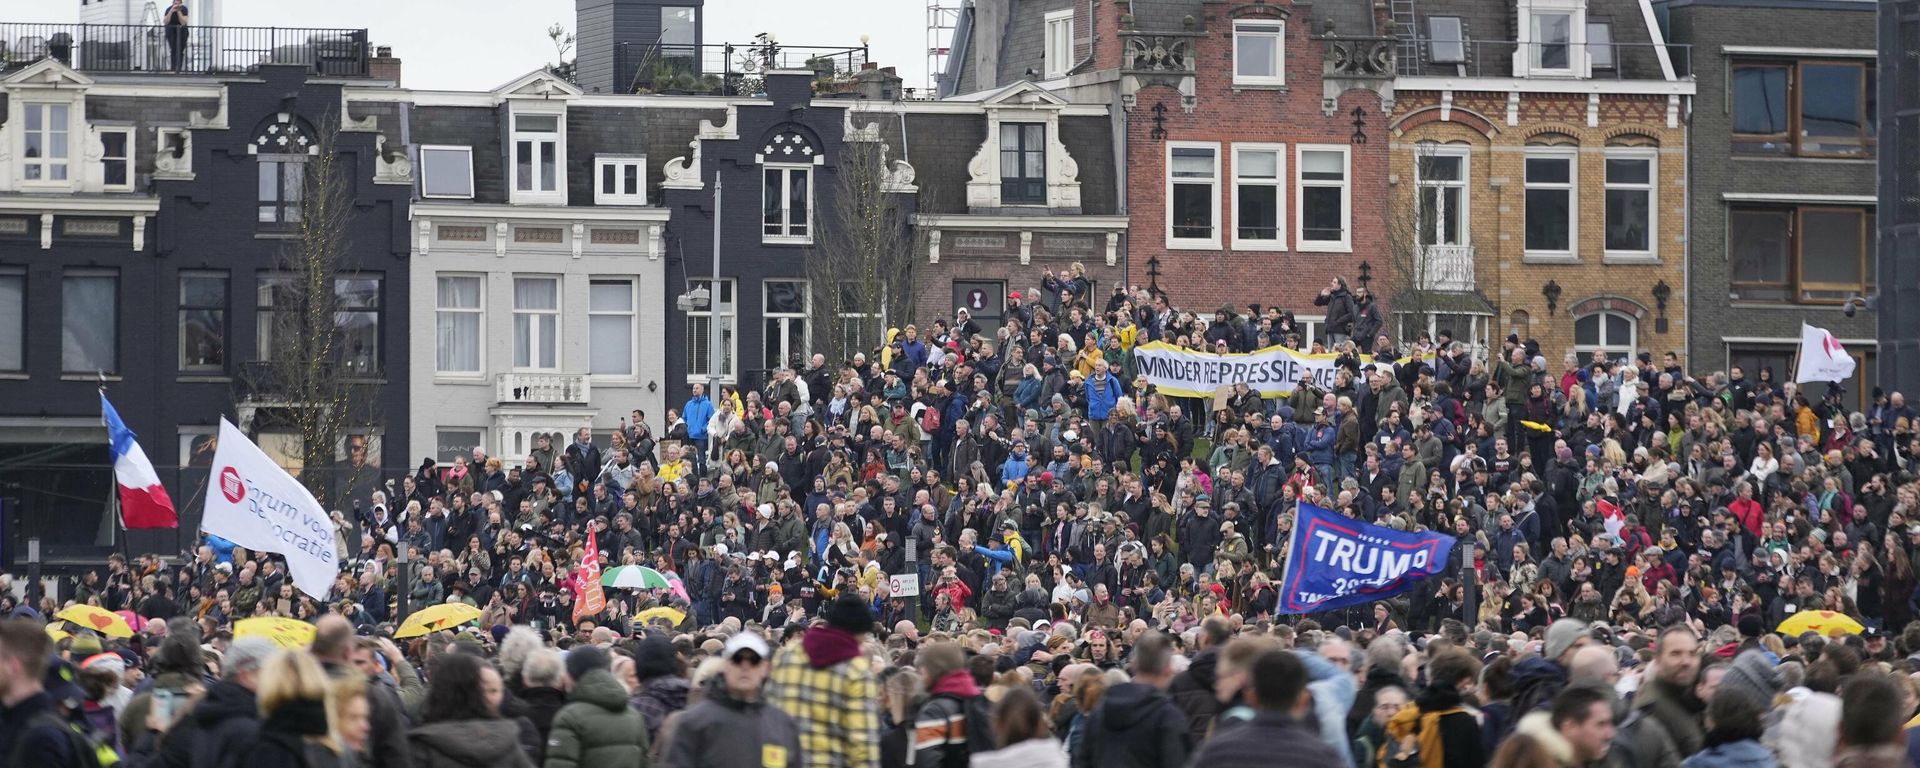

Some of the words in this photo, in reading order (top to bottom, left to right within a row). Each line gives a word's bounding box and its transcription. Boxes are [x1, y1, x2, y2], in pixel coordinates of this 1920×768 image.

[1136, 355, 1201, 384] MINDER
[1203, 359, 1299, 385] REPRESSIE
[1306, 366, 1341, 391] ME
[248, 497, 333, 563] Deocratie
[303, 513, 333, 545] voor
